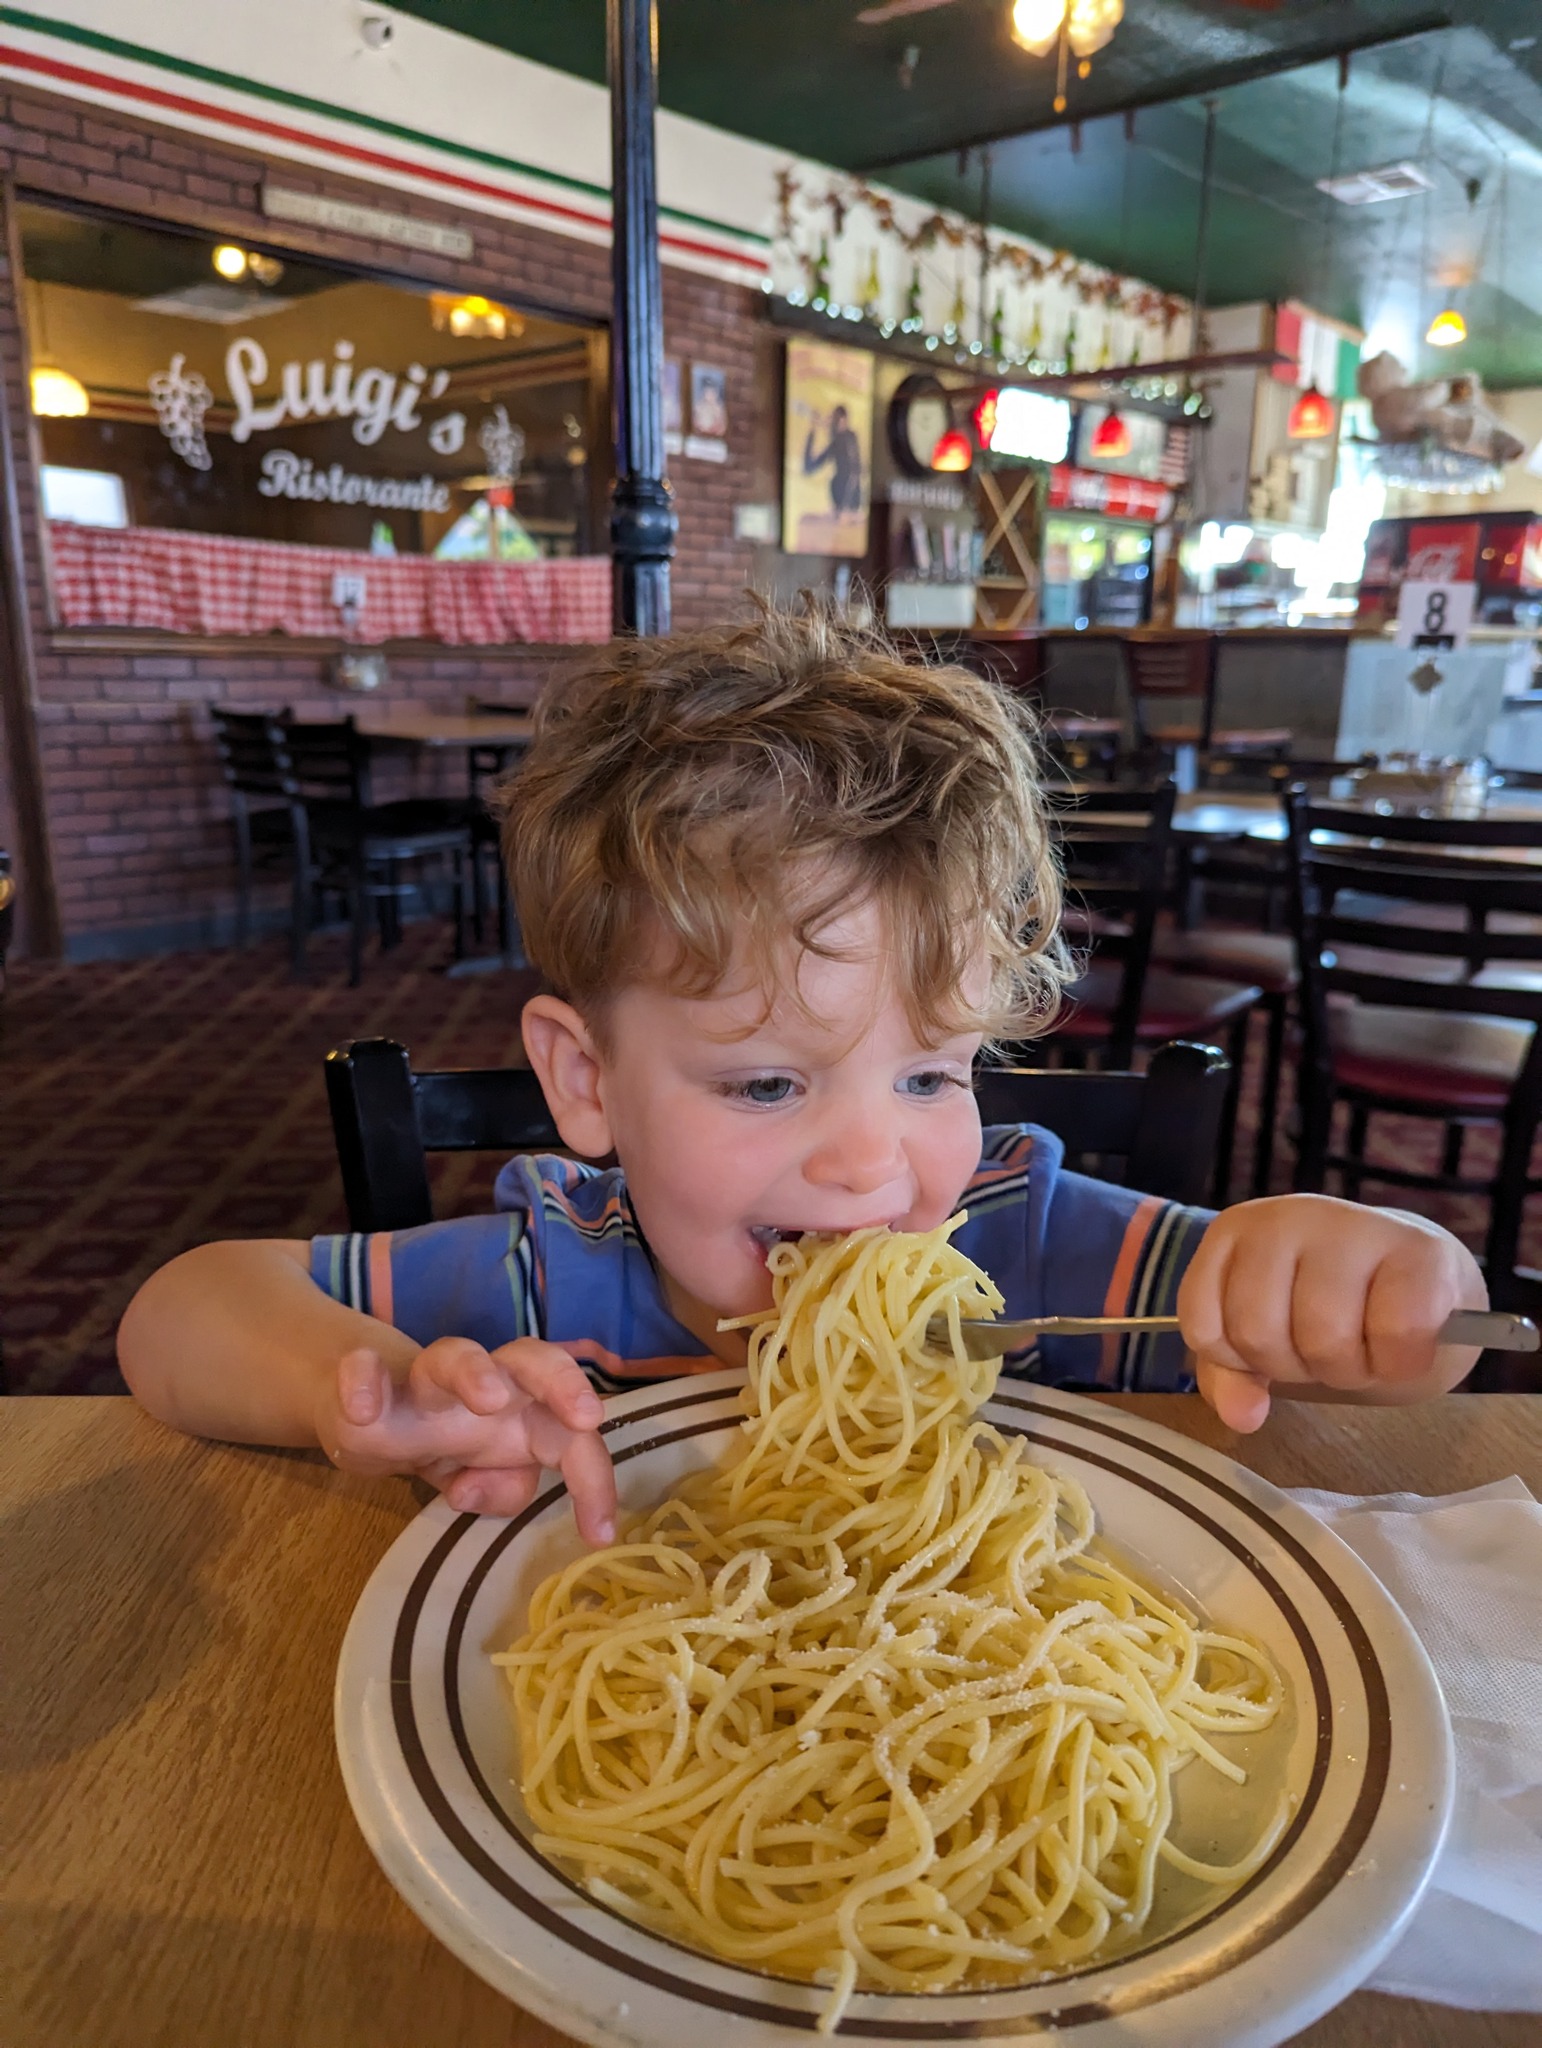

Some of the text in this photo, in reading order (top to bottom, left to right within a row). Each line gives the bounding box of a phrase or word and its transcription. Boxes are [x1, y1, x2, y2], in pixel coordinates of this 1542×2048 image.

[226, 337, 466, 454] Luigi's
[258, 450, 450, 513] Ristorante
[1424, 591, 1447, 635] 8
